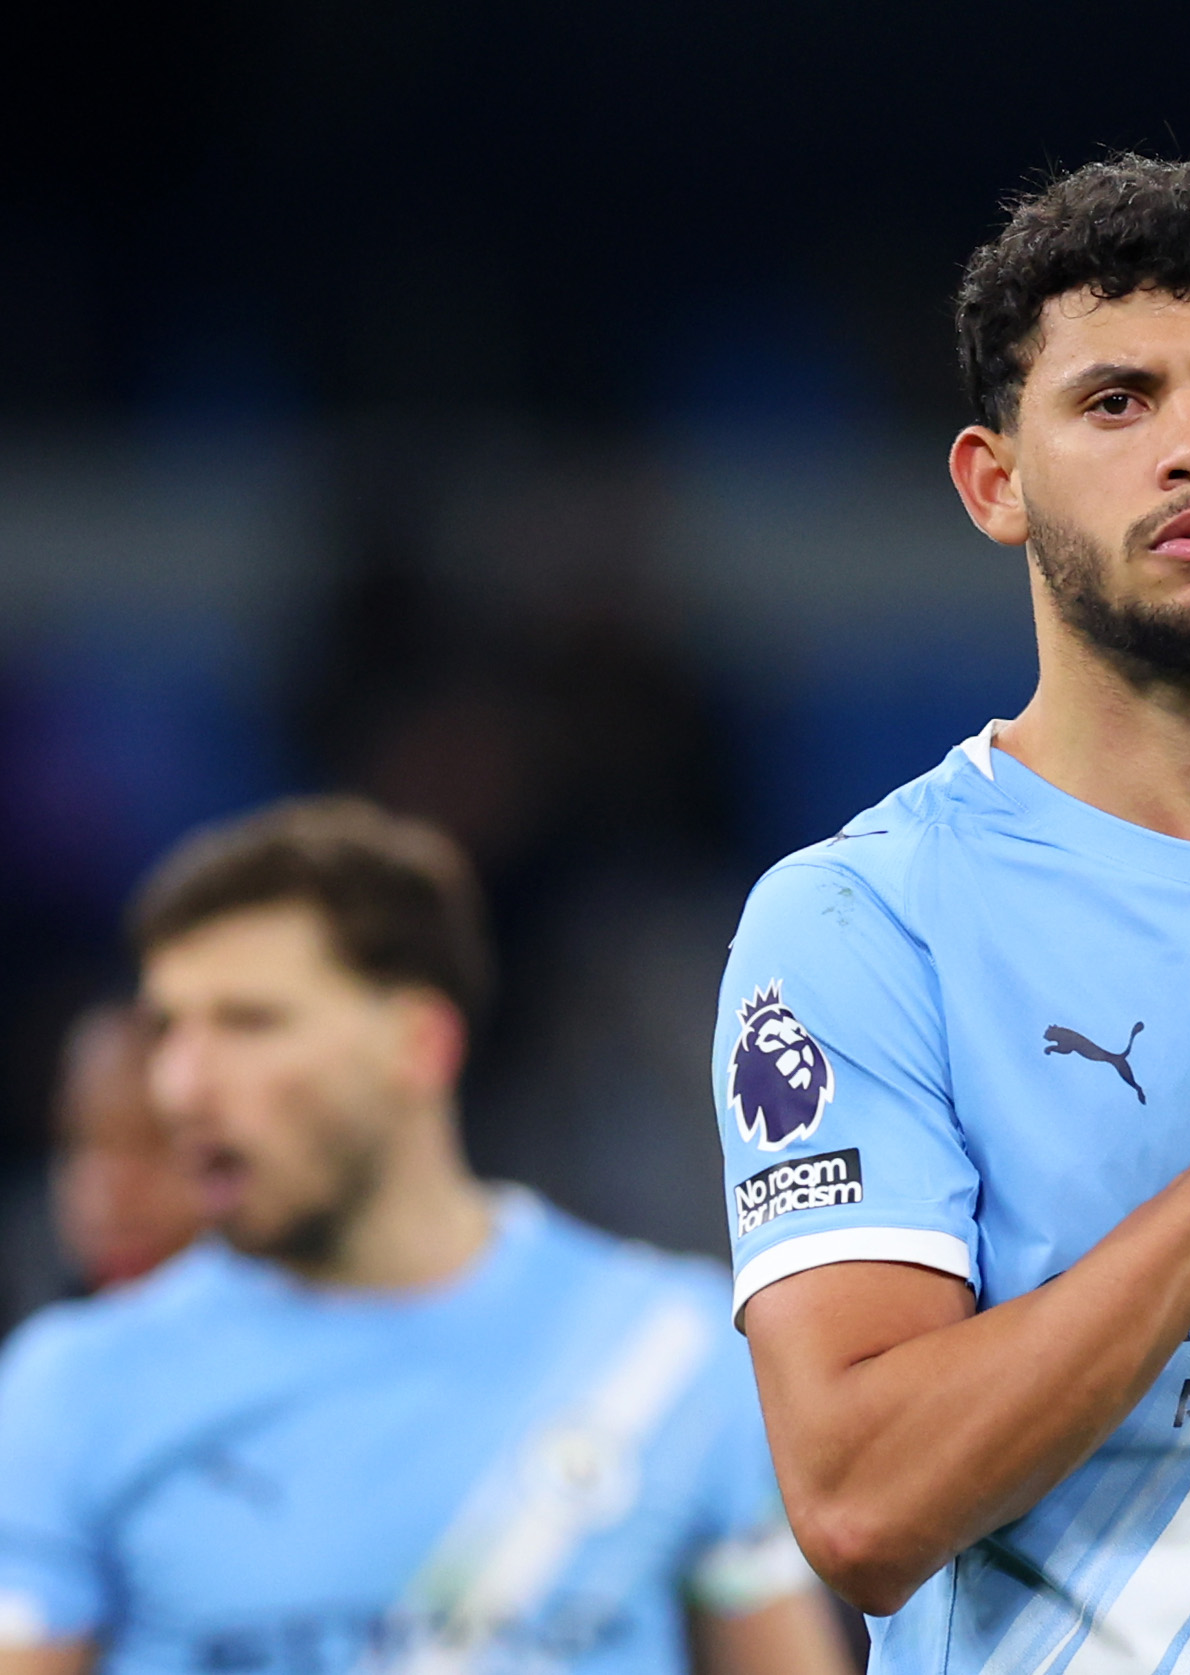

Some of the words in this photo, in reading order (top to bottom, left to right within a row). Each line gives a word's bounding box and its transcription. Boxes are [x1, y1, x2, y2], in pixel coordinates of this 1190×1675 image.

[735, 1180, 767, 1212] No
[769, 1157, 847, 1197] room
[769, 1181, 862, 1220] racism
